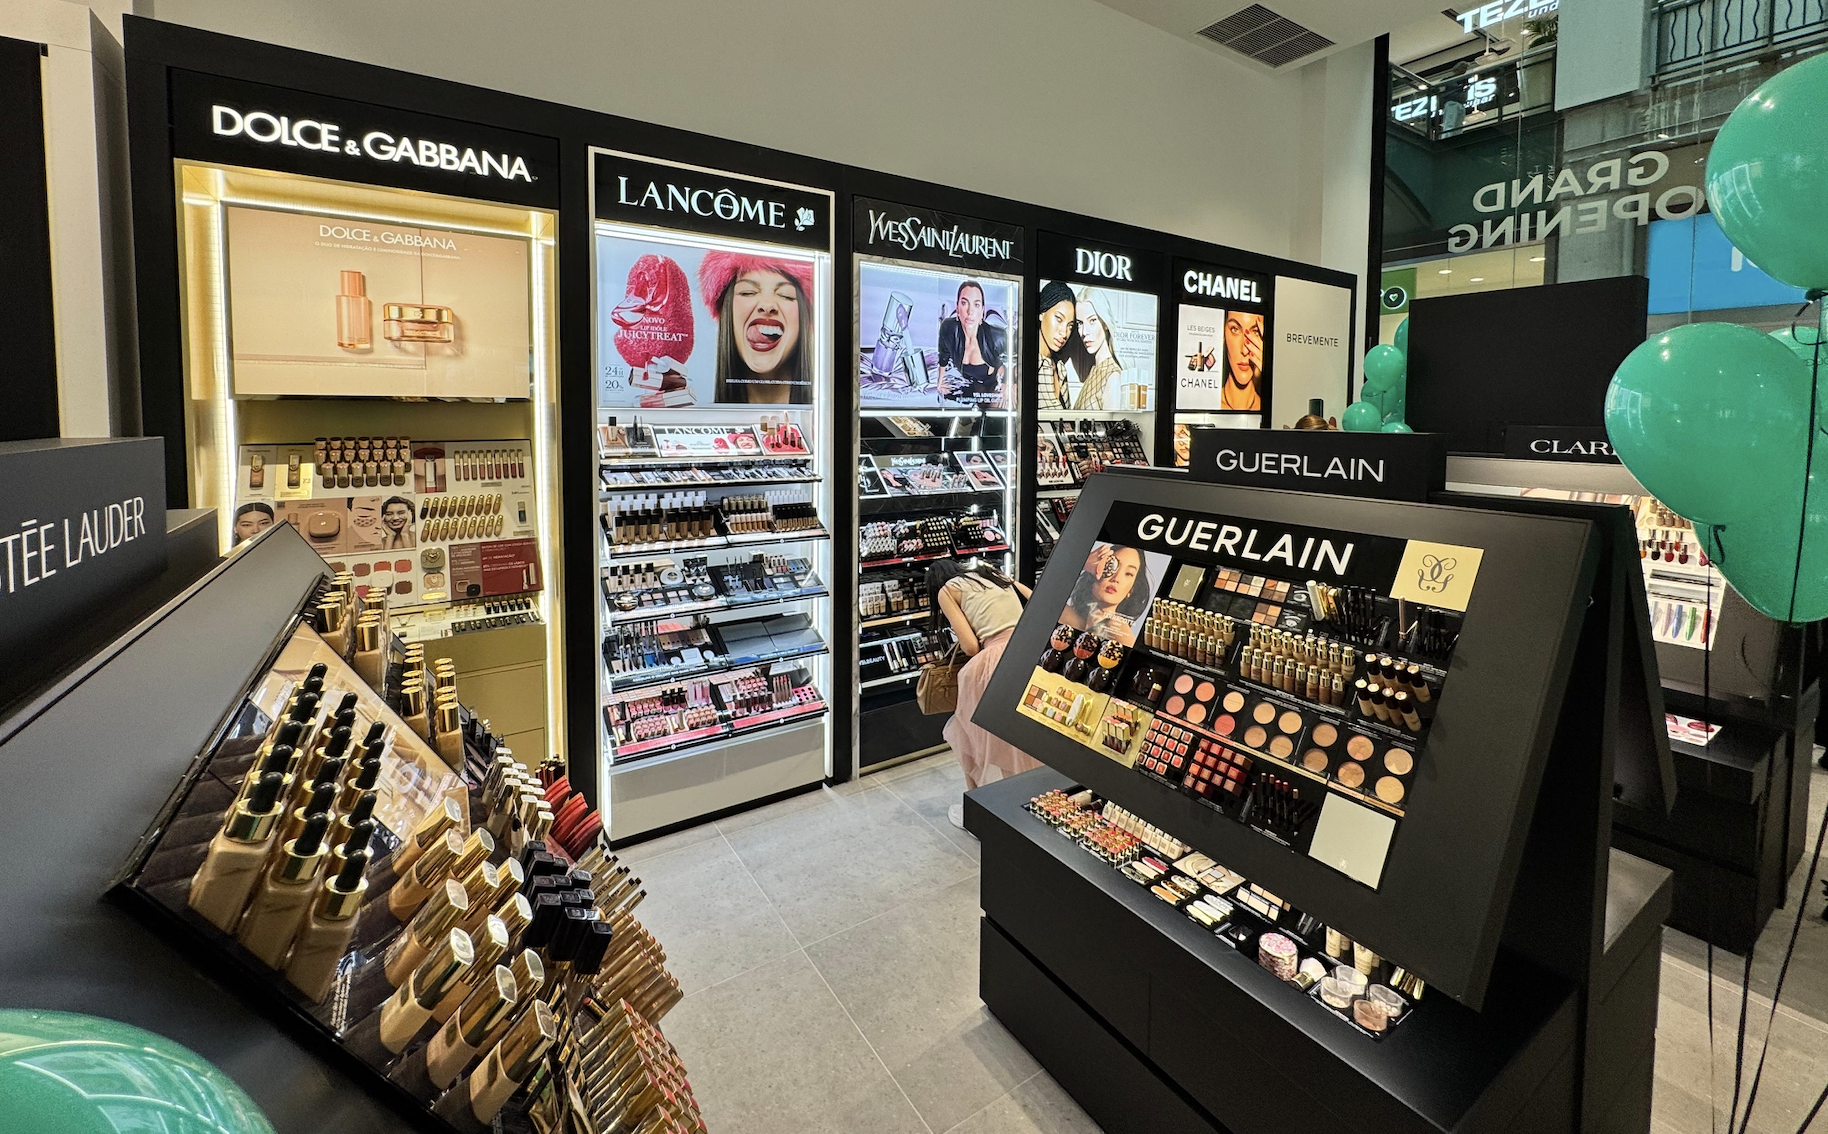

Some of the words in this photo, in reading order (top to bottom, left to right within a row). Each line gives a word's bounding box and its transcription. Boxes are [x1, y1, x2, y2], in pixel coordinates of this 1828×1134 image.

[212, 104, 340, 153] DOLCE
[345, 140, 360, 156] &
[363, 131, 532, 183] GABBANA
[618, 176, 786, 229] LANCÔME
[319, 225, 371, 242] DOLCE
[380, 231, 457, 251] GABBANA
[1075, 248, 1132, 281] DIOR
[1183, 270, 1262, 303] CHANEL
[643, 316, 665, 324] NOVO
[1197, 325, 1216, 333] BEIGES
[1286, 332, 1339, 348] BREVEMENTE
[1180, 378, 1218, 389] CHANEL
[1216, 449, 1385, 483] GUERLAIN
[64, 496, 146, 569] LAUDER
[1137, 513, 1354, 576] GUERLAIN
